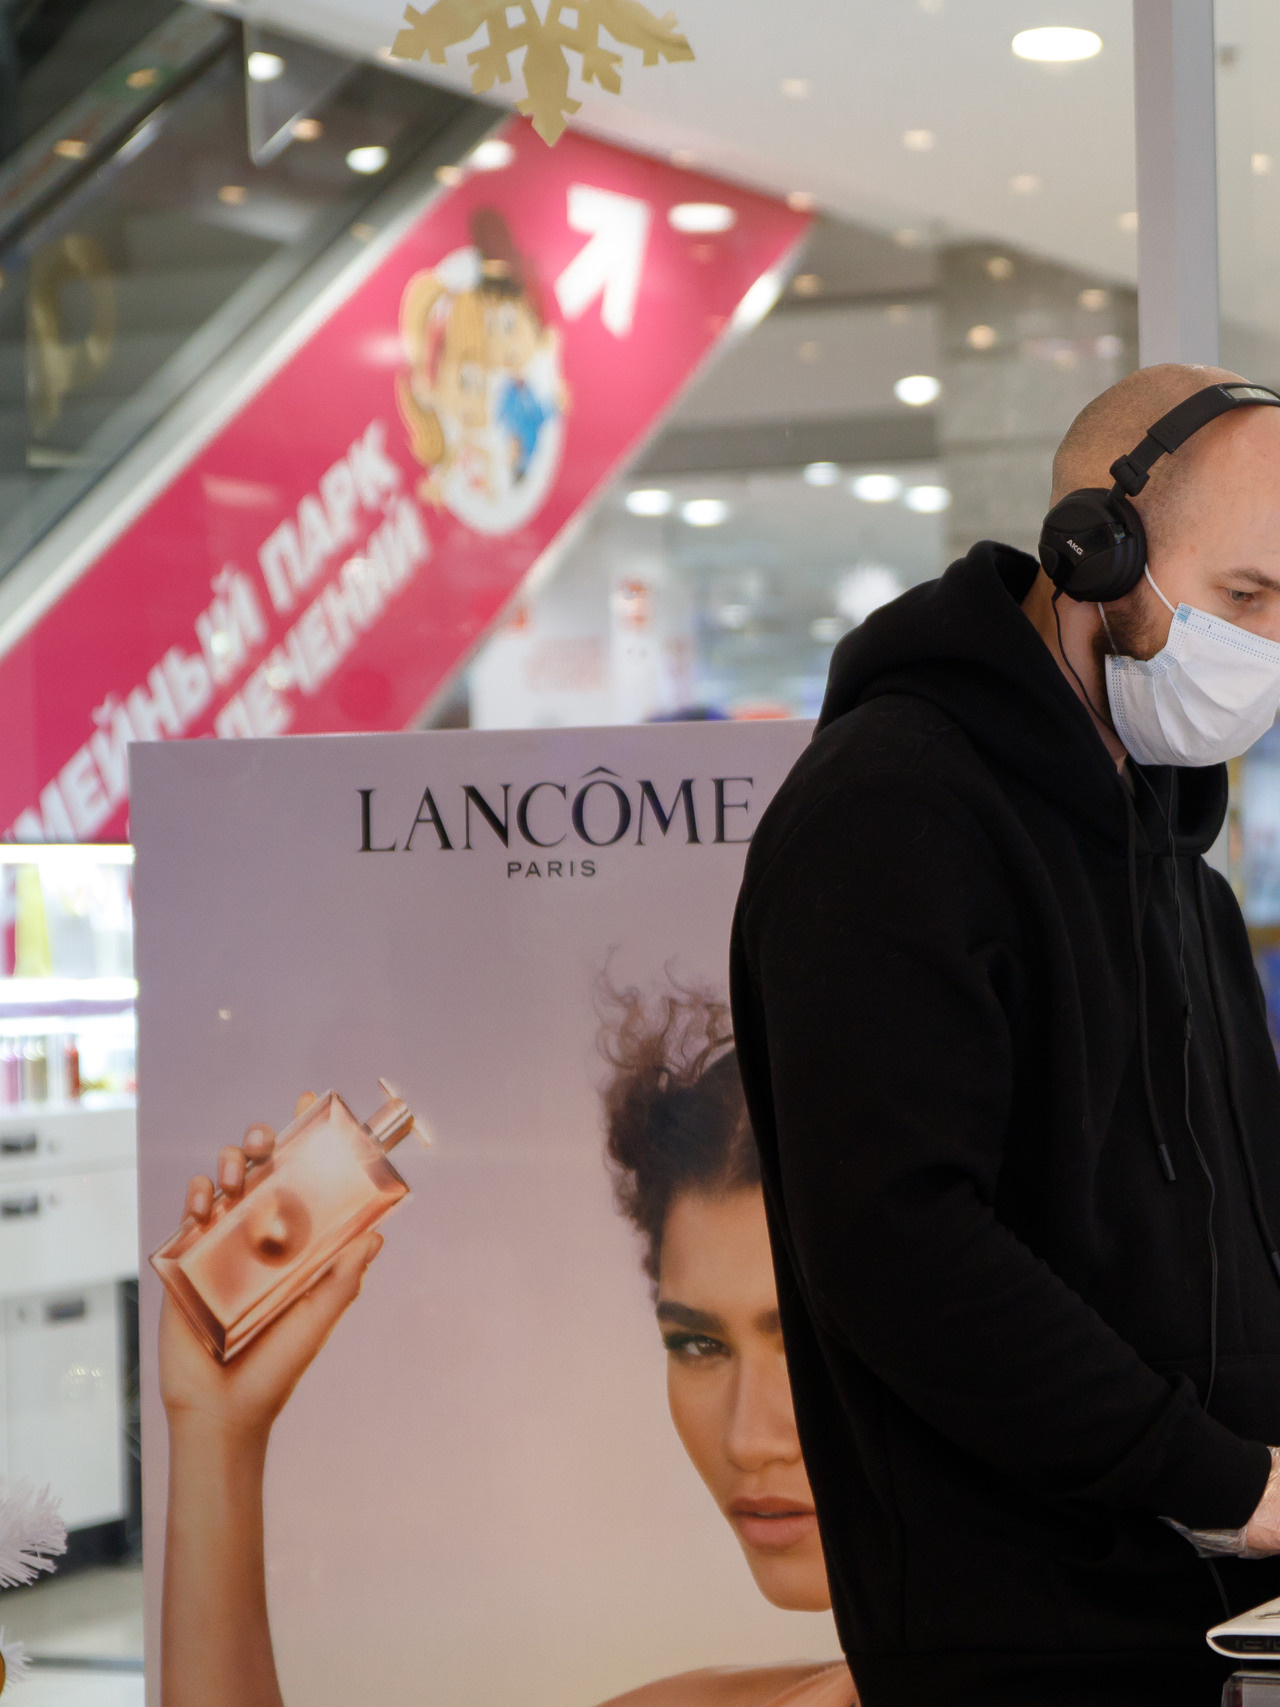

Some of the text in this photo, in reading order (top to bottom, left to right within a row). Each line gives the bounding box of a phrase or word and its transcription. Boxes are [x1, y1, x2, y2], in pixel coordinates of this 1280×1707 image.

[1066, 539, 1084, 555] AKG
[5, 417, 403, 843] МЕЙНЫЙ ПАРК
[356, 765, 755, 852] LANCÔME
[507, 859, 597, 879] PARIS
